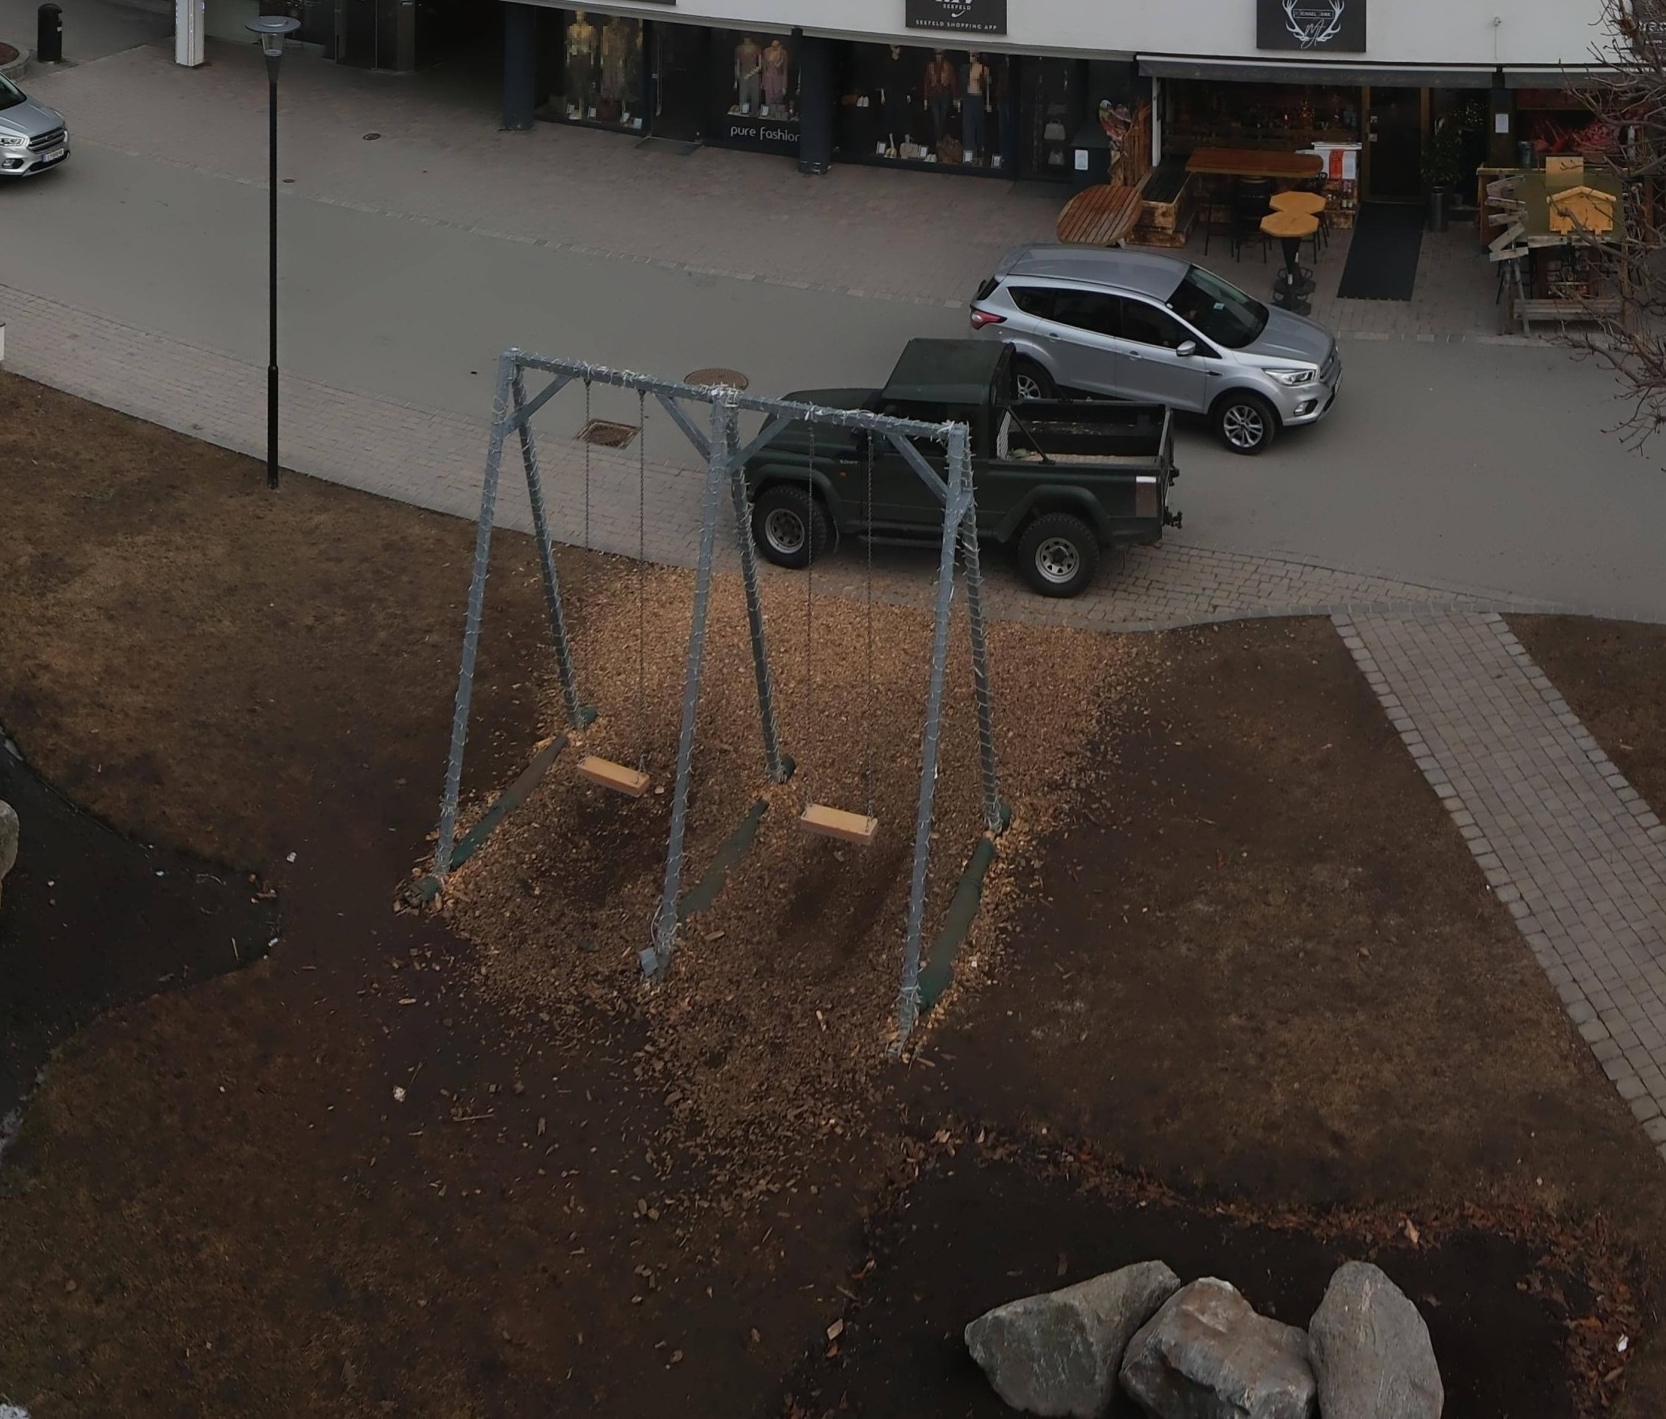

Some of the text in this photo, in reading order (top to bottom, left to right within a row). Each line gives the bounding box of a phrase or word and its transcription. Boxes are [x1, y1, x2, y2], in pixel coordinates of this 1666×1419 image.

[942, 3, 972, 11] SEEFELD
[915, 19, 945, 27] SEEFELD
[946, 21, 983, 30] SHOPPING
[730, 126, 757, 138] pure
